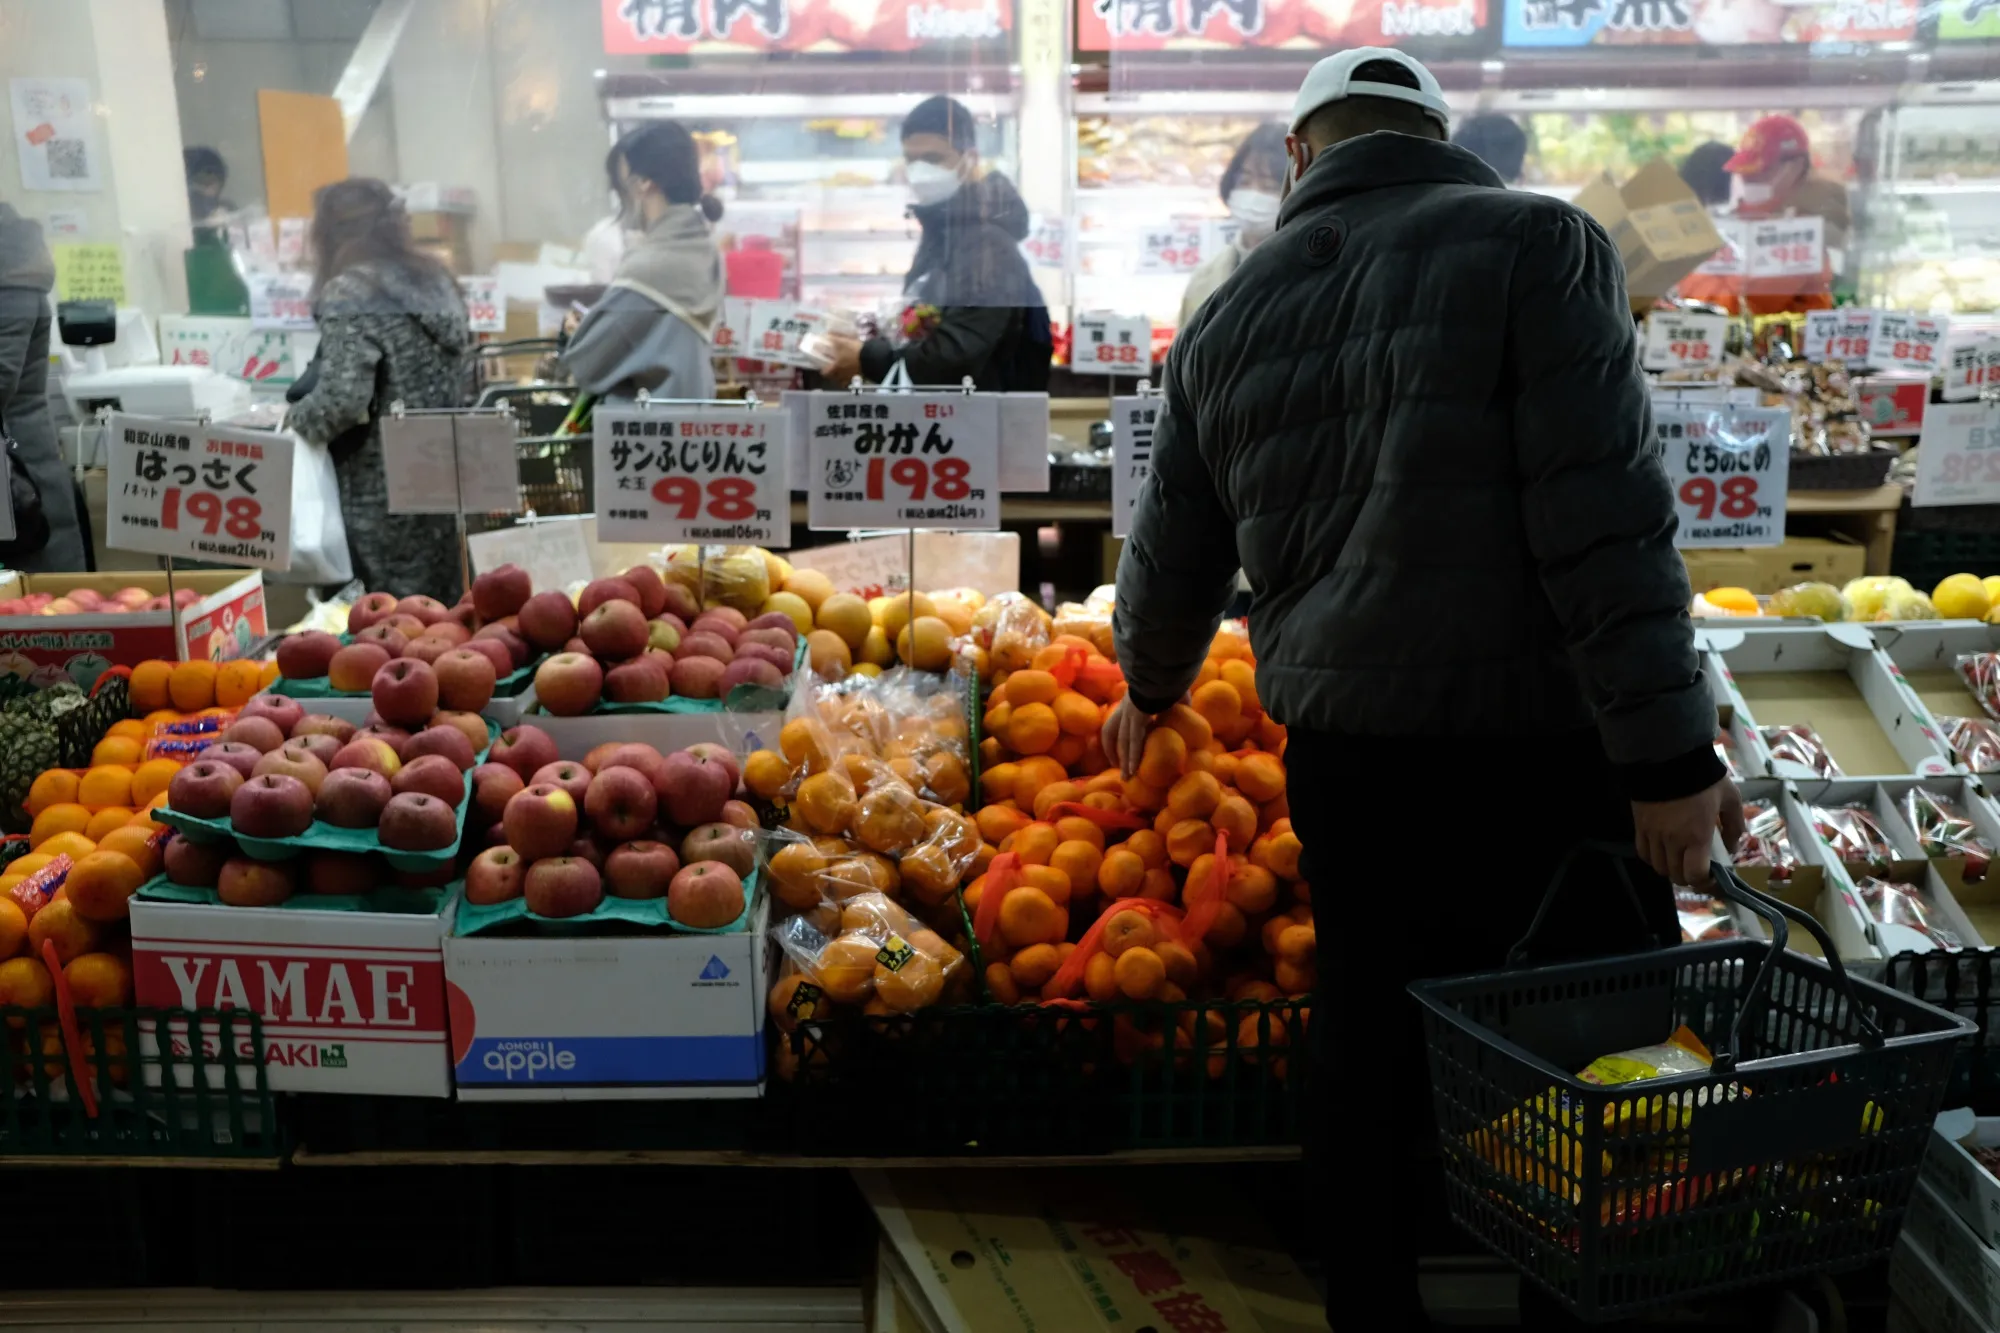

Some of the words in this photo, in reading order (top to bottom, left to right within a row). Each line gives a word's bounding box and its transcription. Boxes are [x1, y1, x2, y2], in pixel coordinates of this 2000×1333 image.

[924, 404, 954, 418] 甘い
[854, 422, 954, 454] みかん
[136, 451, 258, 495] はっさく
[610, 440, 768, 475] サンふじりんご
[160, 956, 417, 1026] YAMAE
[483, 1042, 576, 1080] apple
[497, 1042, 545, 1051] AOMORI
